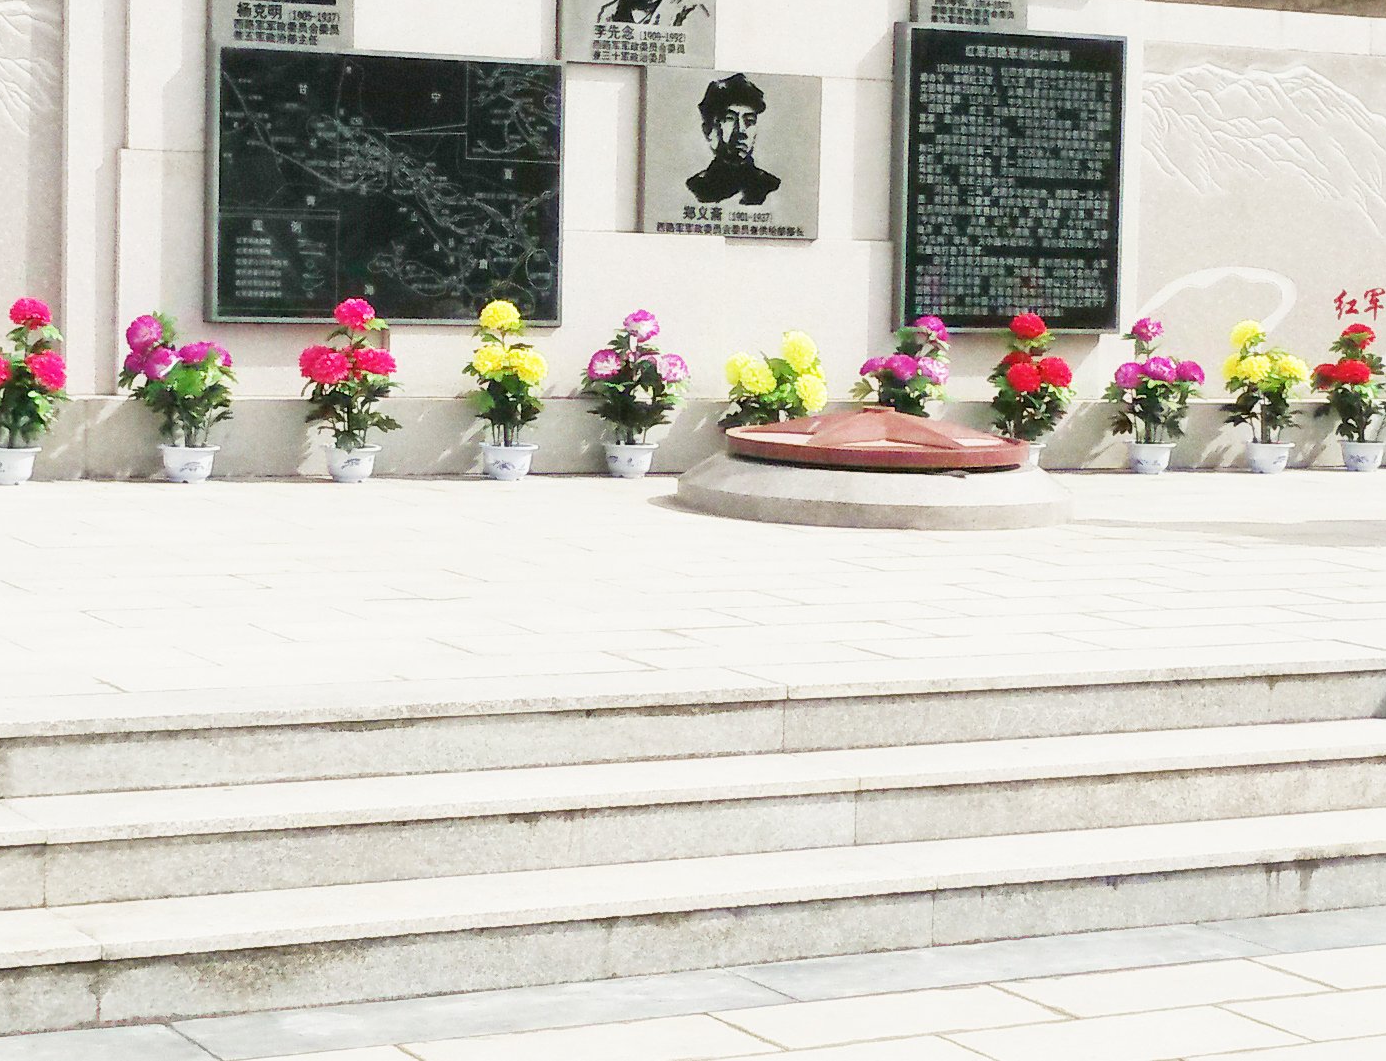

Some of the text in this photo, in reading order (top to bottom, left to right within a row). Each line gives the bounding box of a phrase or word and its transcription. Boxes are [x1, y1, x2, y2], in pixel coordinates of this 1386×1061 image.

[236, 1, 283, 20] 杨克明
[593, 24, 634, 41] 李先念
[683, 205, 723, 221] 郑义斋
